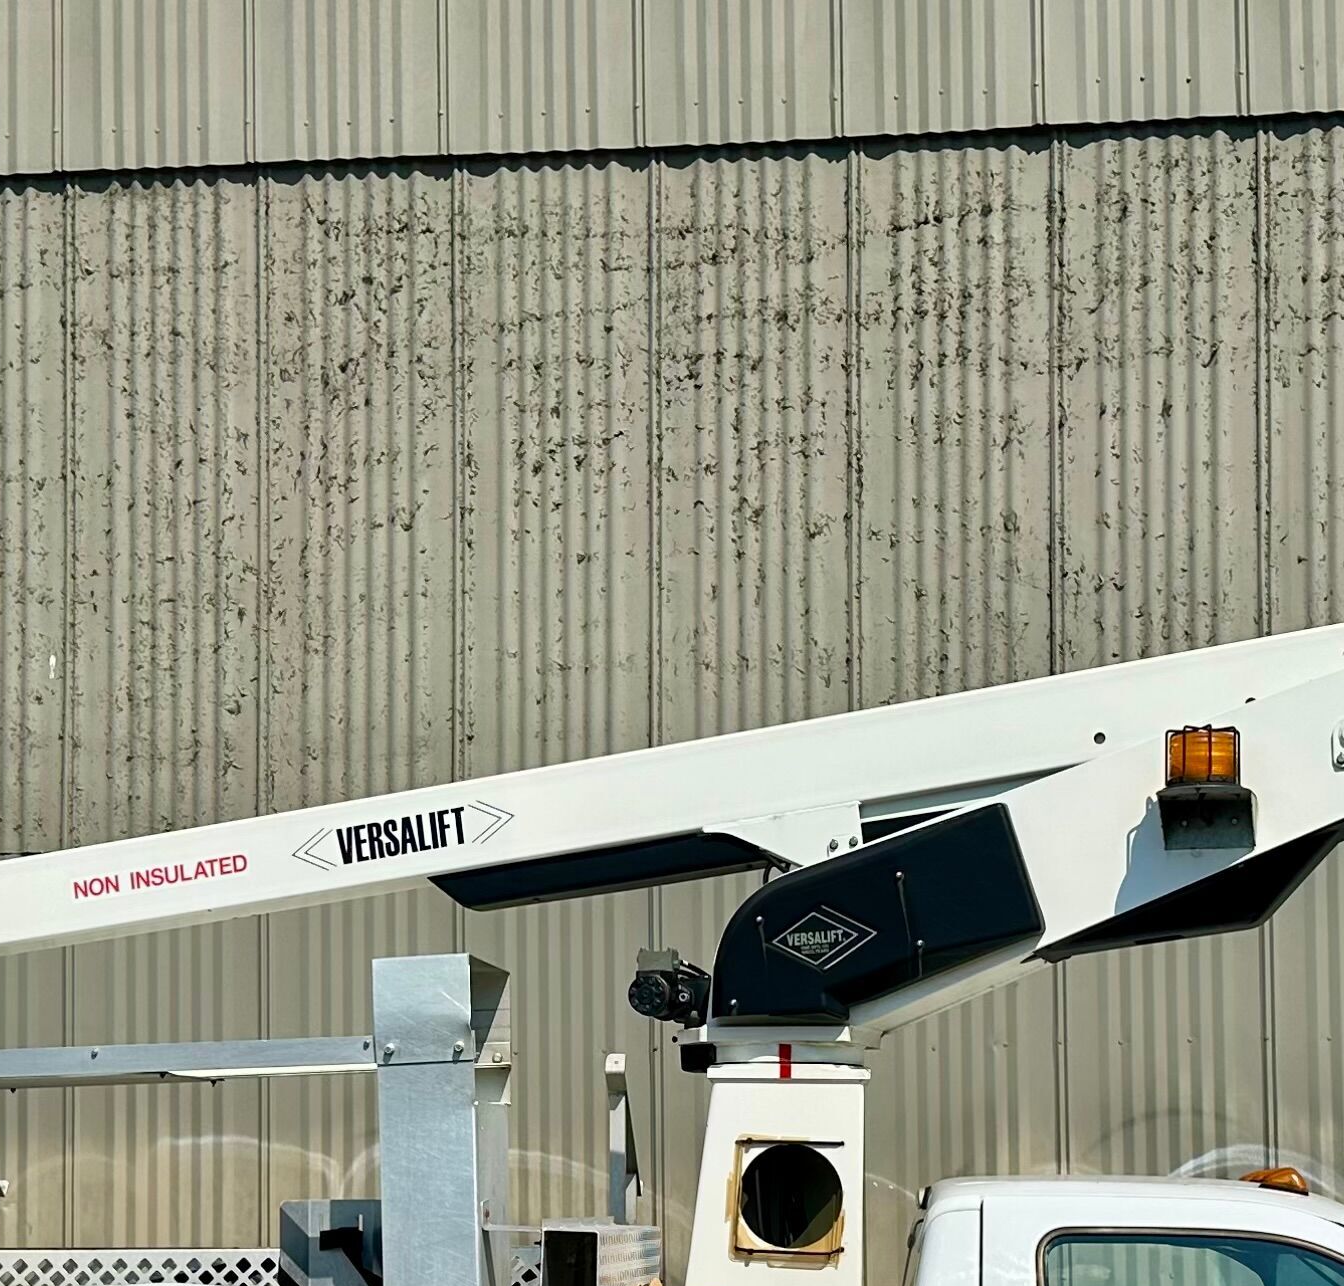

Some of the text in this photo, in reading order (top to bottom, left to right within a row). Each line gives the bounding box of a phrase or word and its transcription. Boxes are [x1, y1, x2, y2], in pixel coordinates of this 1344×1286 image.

[336, 806, 465, 865] VERSALIFT
[73, 853, 248, 899] NON INSULATED
[786, 929, 844, 947] VERSALIFT
